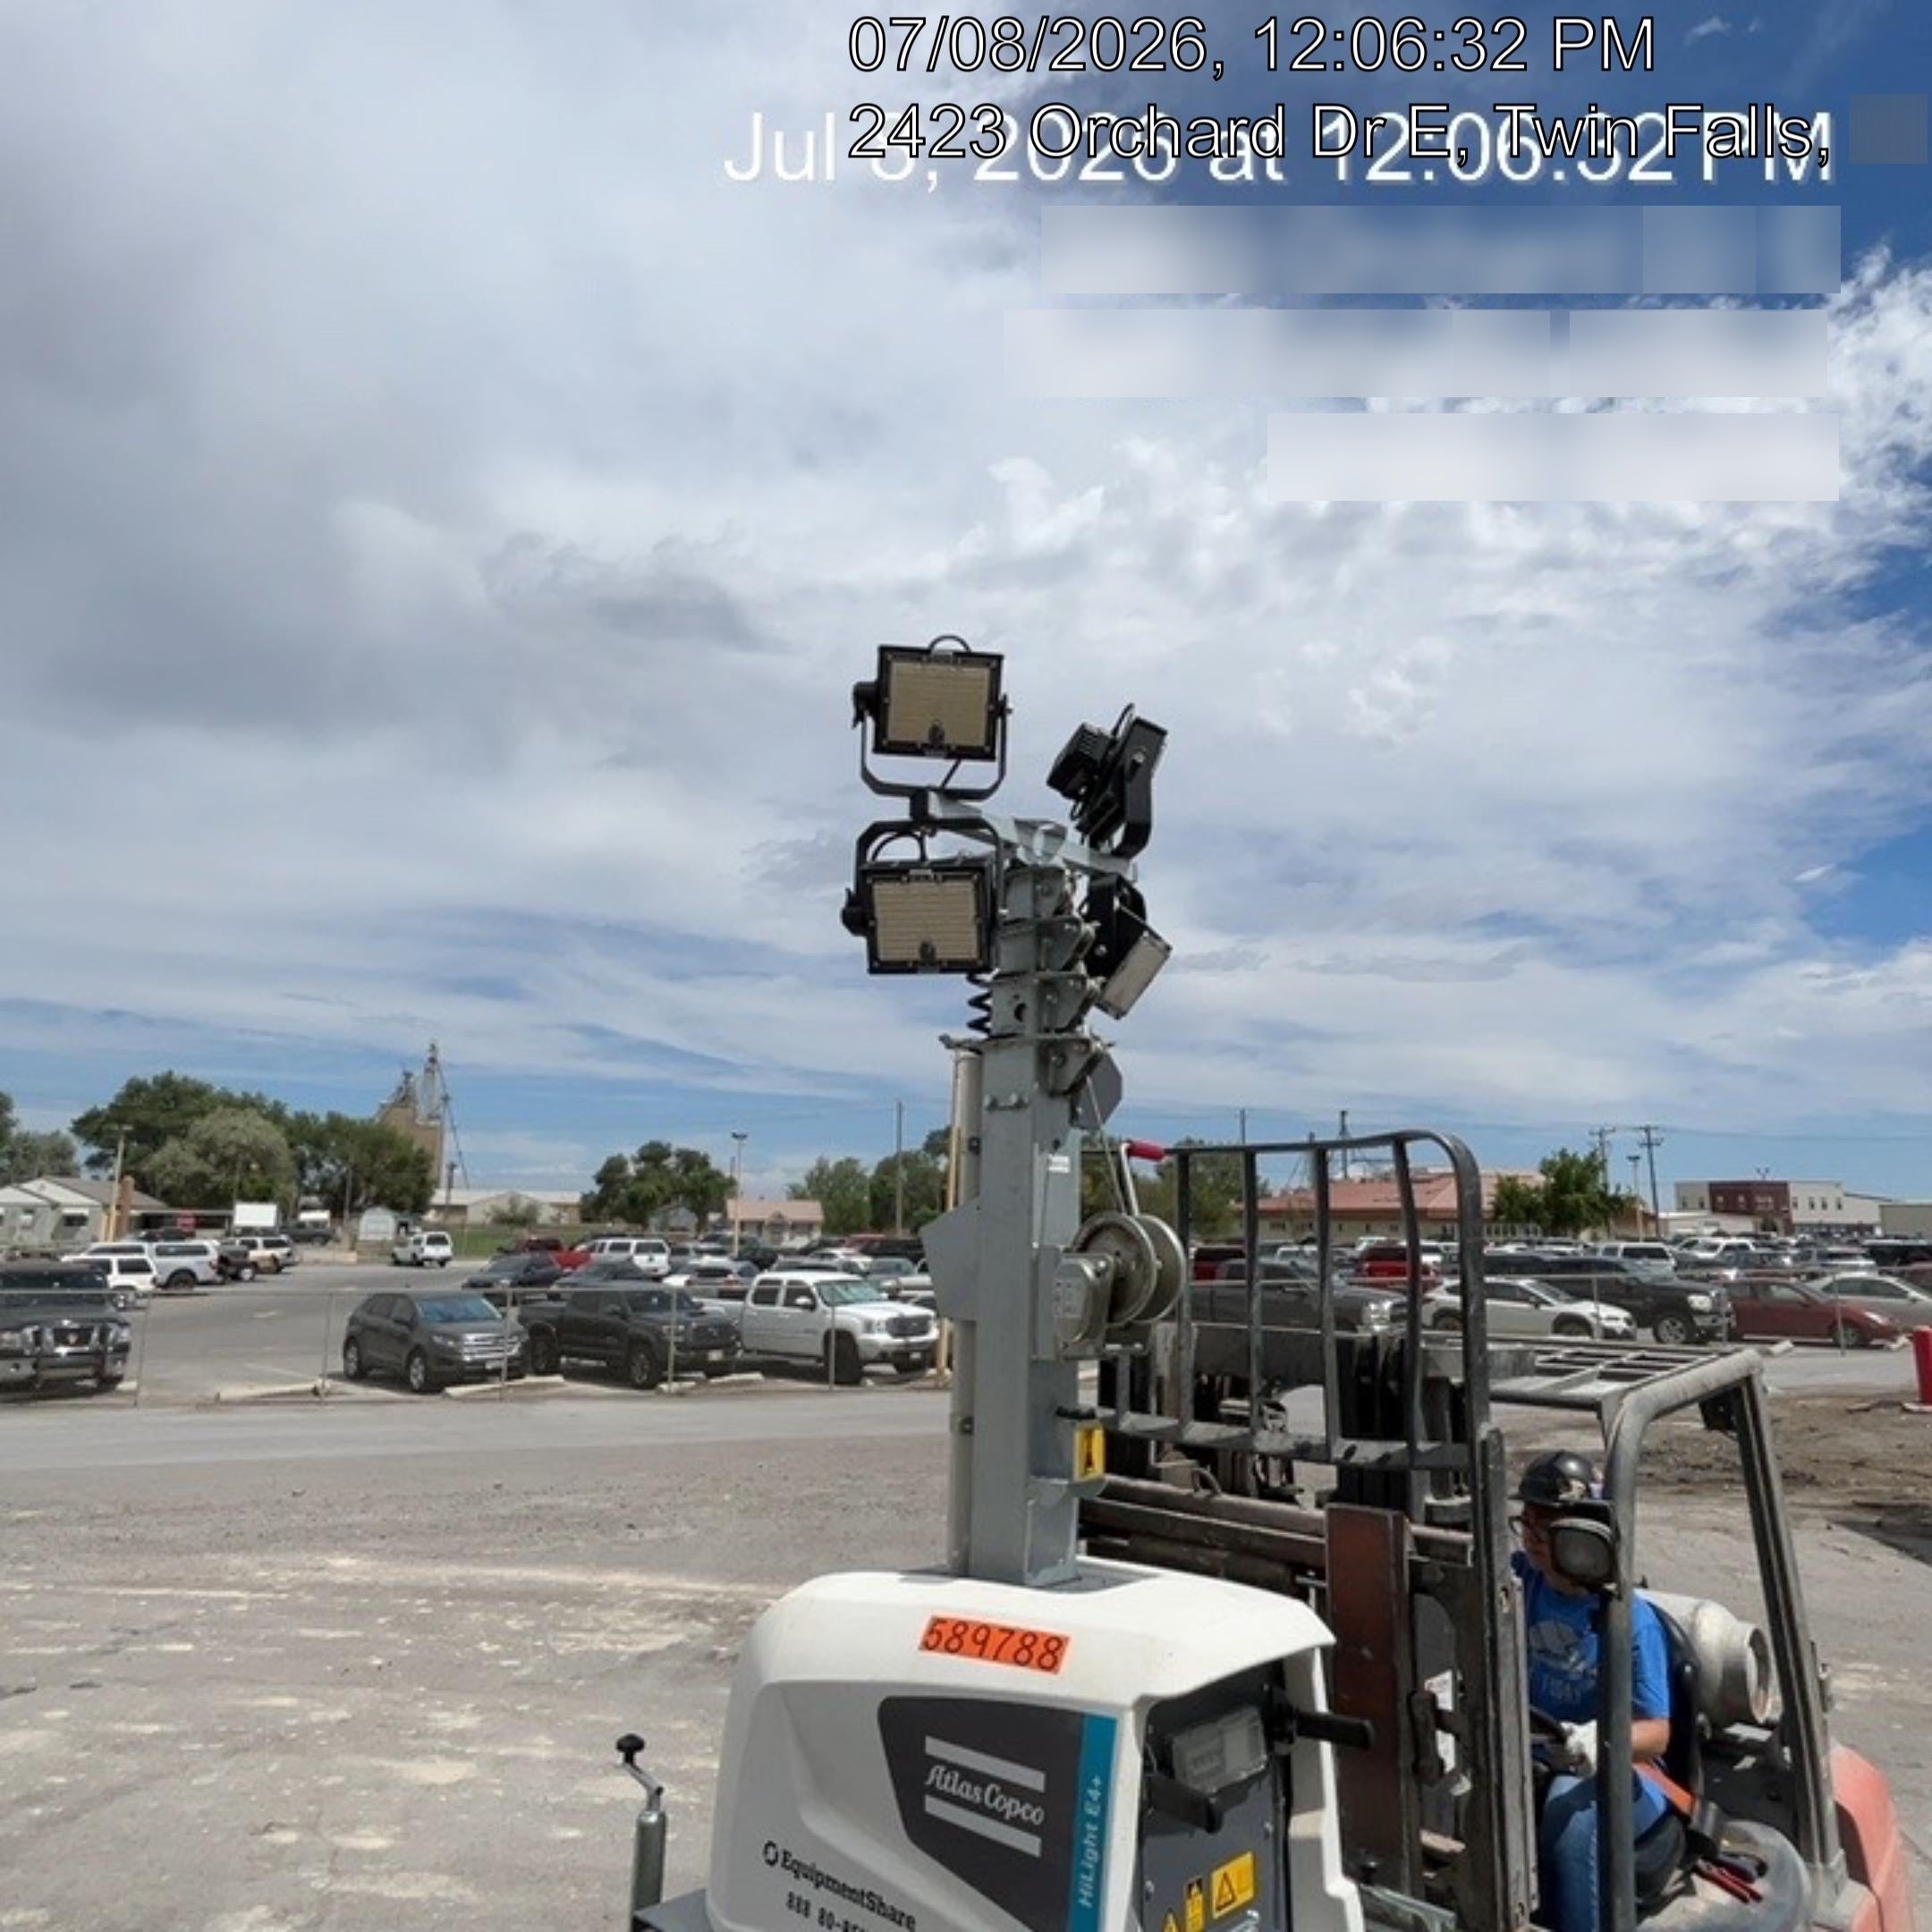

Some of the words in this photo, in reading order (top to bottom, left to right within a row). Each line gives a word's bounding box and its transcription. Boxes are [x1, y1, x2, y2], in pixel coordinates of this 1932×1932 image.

[923, 1617, 1063, 1672] 589788
[925, 1764, 982, 1804] Atlas
[984, 1783, 1045, 1826] Copco
[780, 1848, 916, 1932] EquipmentShare
[1078, 1823, 1099, 1909] HiLight
